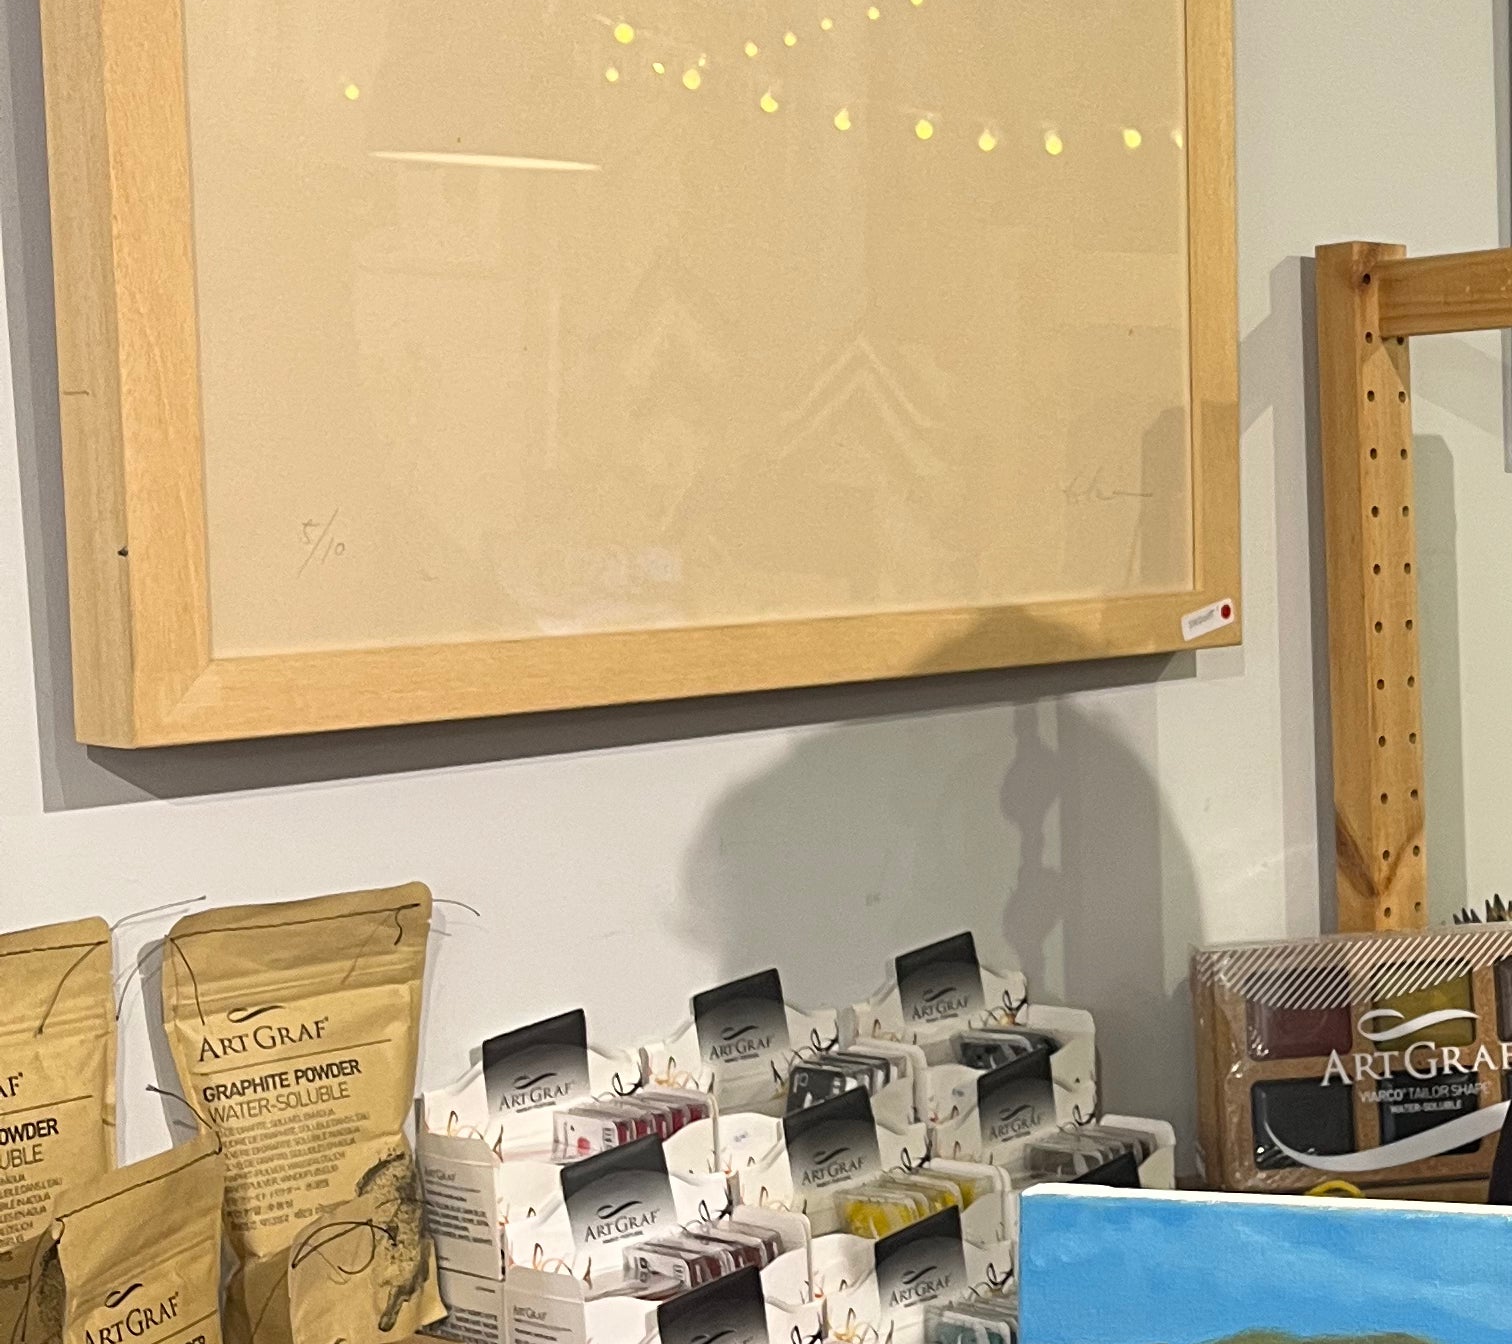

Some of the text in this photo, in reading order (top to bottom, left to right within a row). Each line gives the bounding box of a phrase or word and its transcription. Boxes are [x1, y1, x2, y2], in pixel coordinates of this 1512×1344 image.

[202, 1058, 362, 1103] GRAPHITE POWDER
[206, 1081, 351, 1125] WATER-SOLUBLE
